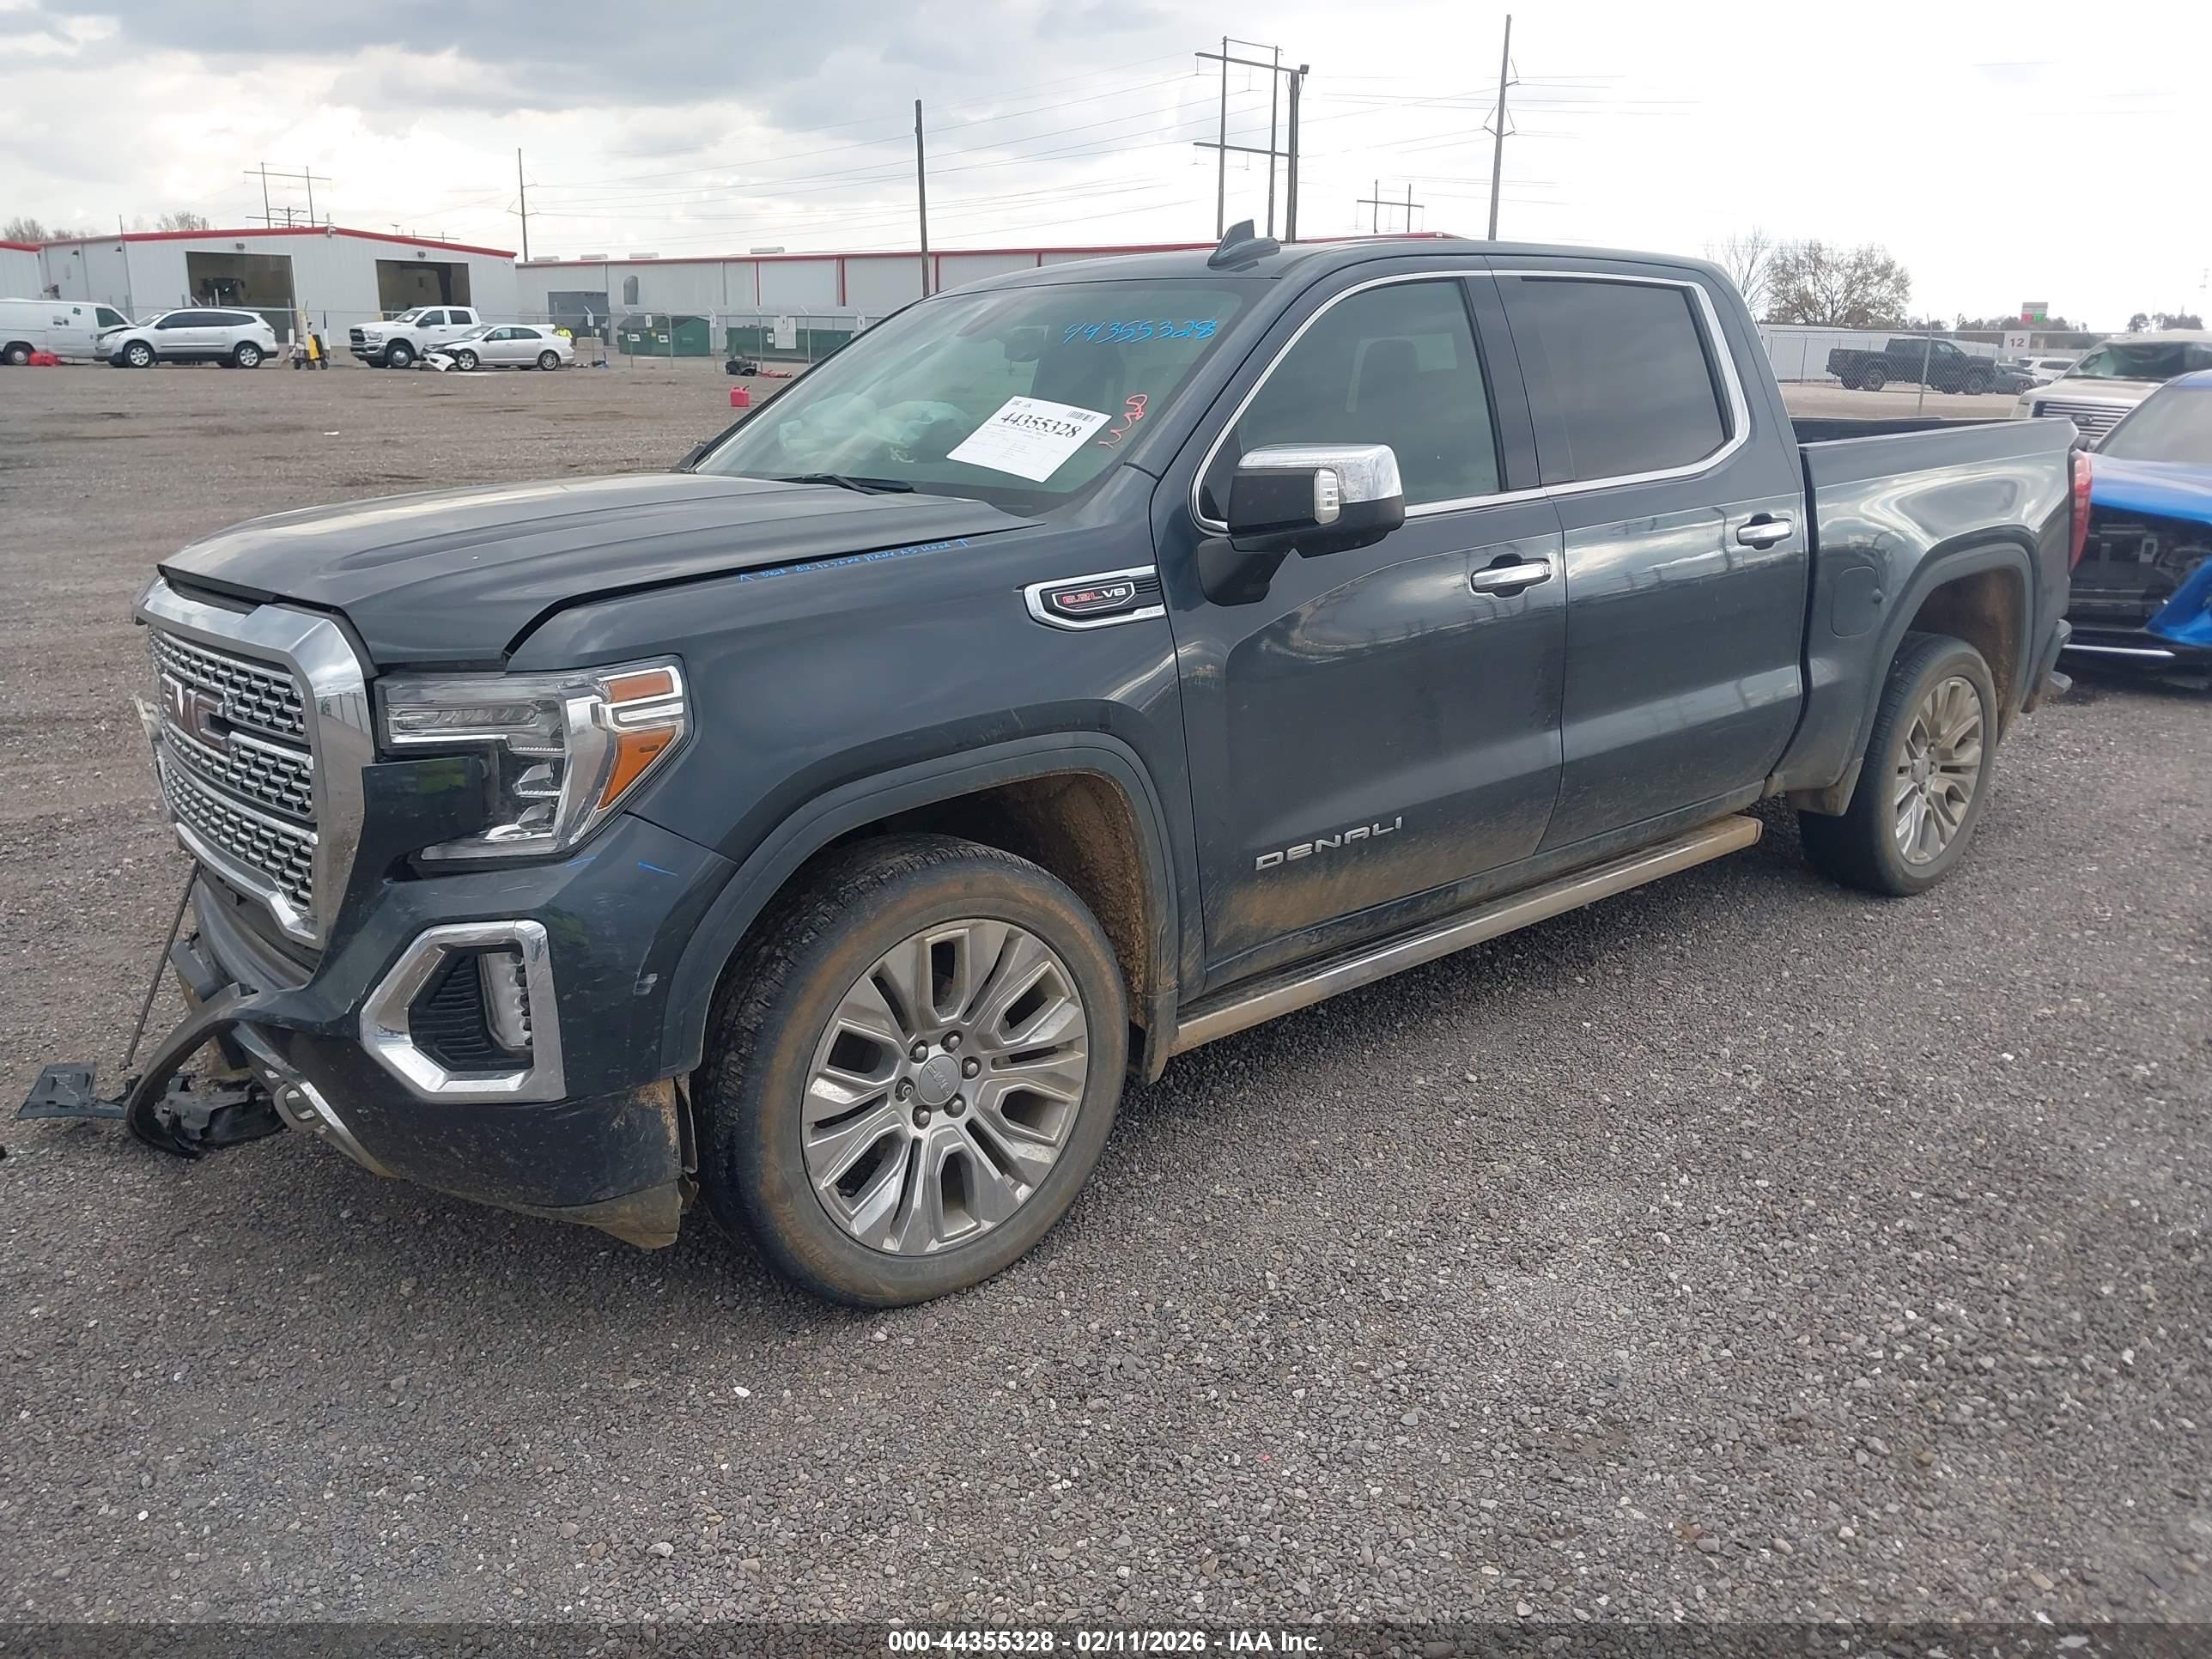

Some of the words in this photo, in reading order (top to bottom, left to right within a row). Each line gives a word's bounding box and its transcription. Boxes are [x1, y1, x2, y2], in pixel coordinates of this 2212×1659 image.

[2010, 337, 2025, 348] 12
[1000, 411, 1082, 439] 44355328
[1102, 587, 1127, 598] V8
[1255, 816, 1402, 871] DENALI
